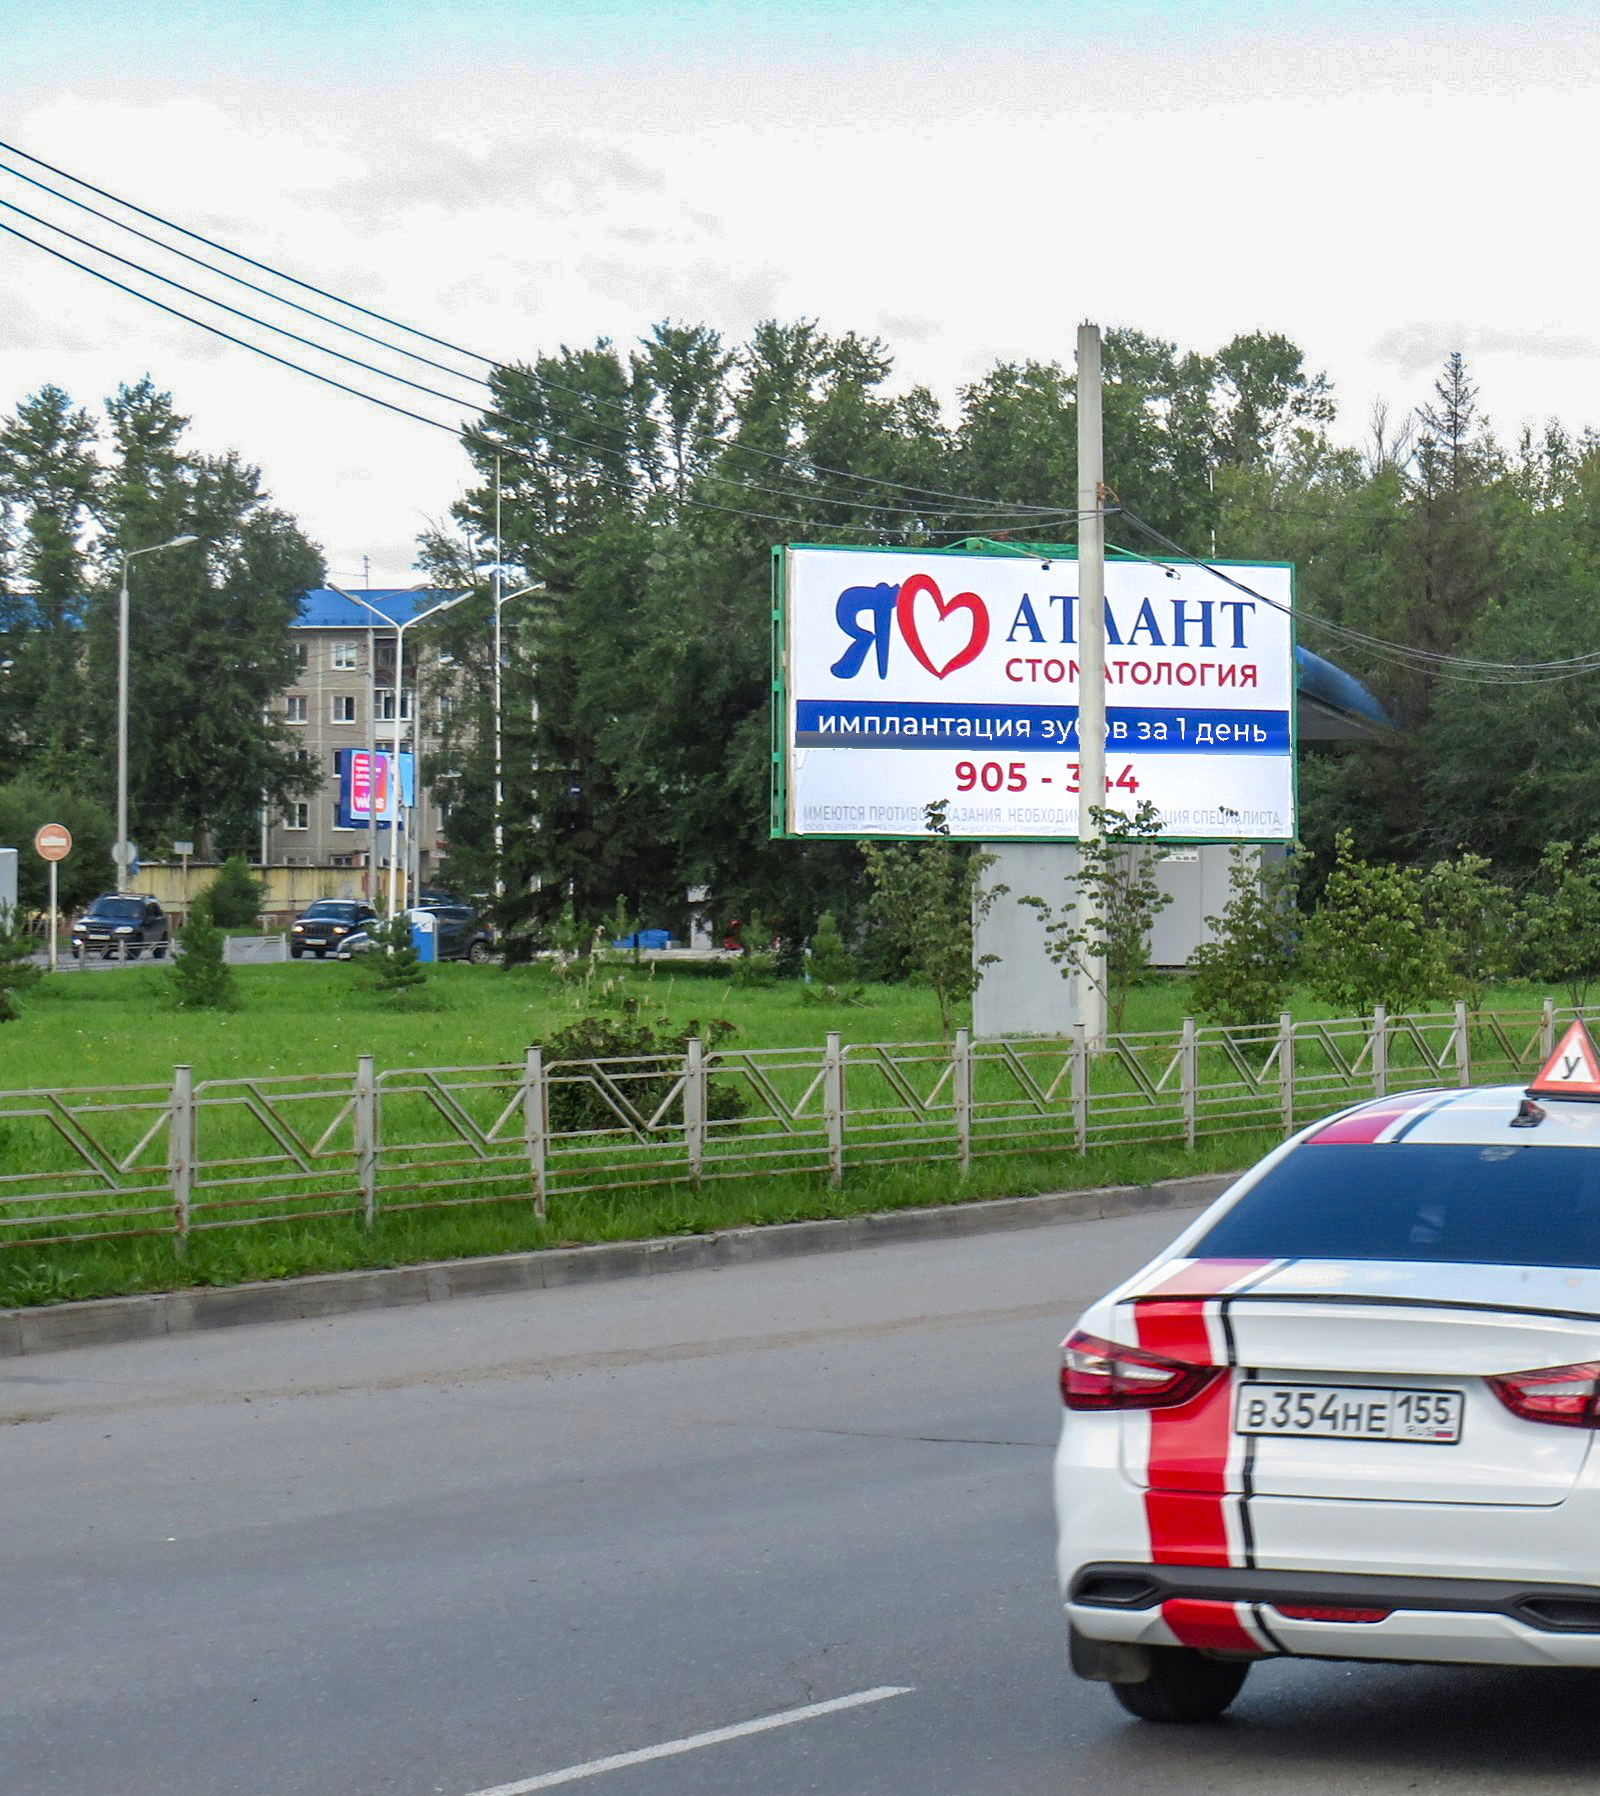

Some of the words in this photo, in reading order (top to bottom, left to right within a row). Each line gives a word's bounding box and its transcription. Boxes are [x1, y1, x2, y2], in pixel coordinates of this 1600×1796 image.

[818, 714, 1031, 741] имплантация
[1137, 721, 1168, 741] за
[1176, 717, 1186, 741] 1
[1195, 722, 1267, 745] день
[955, 761, 1028, 793] 905
[803, 805, 865, 822] ИМЕЮТСЯ
[1398, 1395, 1451, 1425] 155
